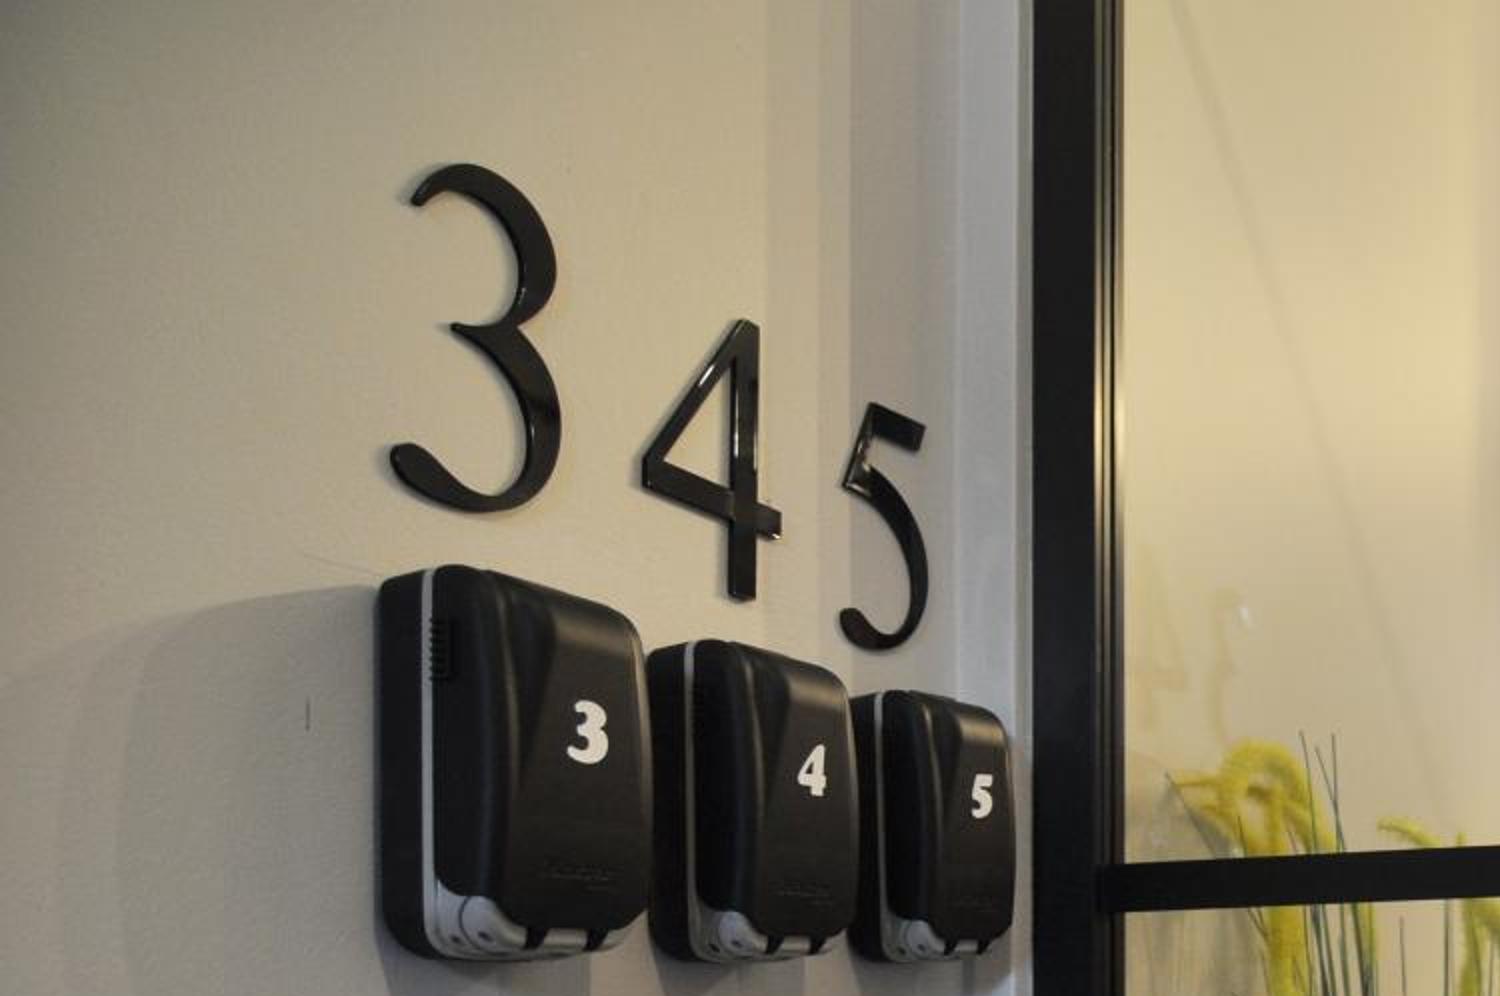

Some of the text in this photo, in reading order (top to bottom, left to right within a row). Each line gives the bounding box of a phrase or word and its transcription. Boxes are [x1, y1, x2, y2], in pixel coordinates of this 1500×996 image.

[388, 163, 561, 513] 3
[641, 319, 782, 601] 4
[840, 403, 929, 650] 5
[567, 700, 994, 819] 3 4 5
